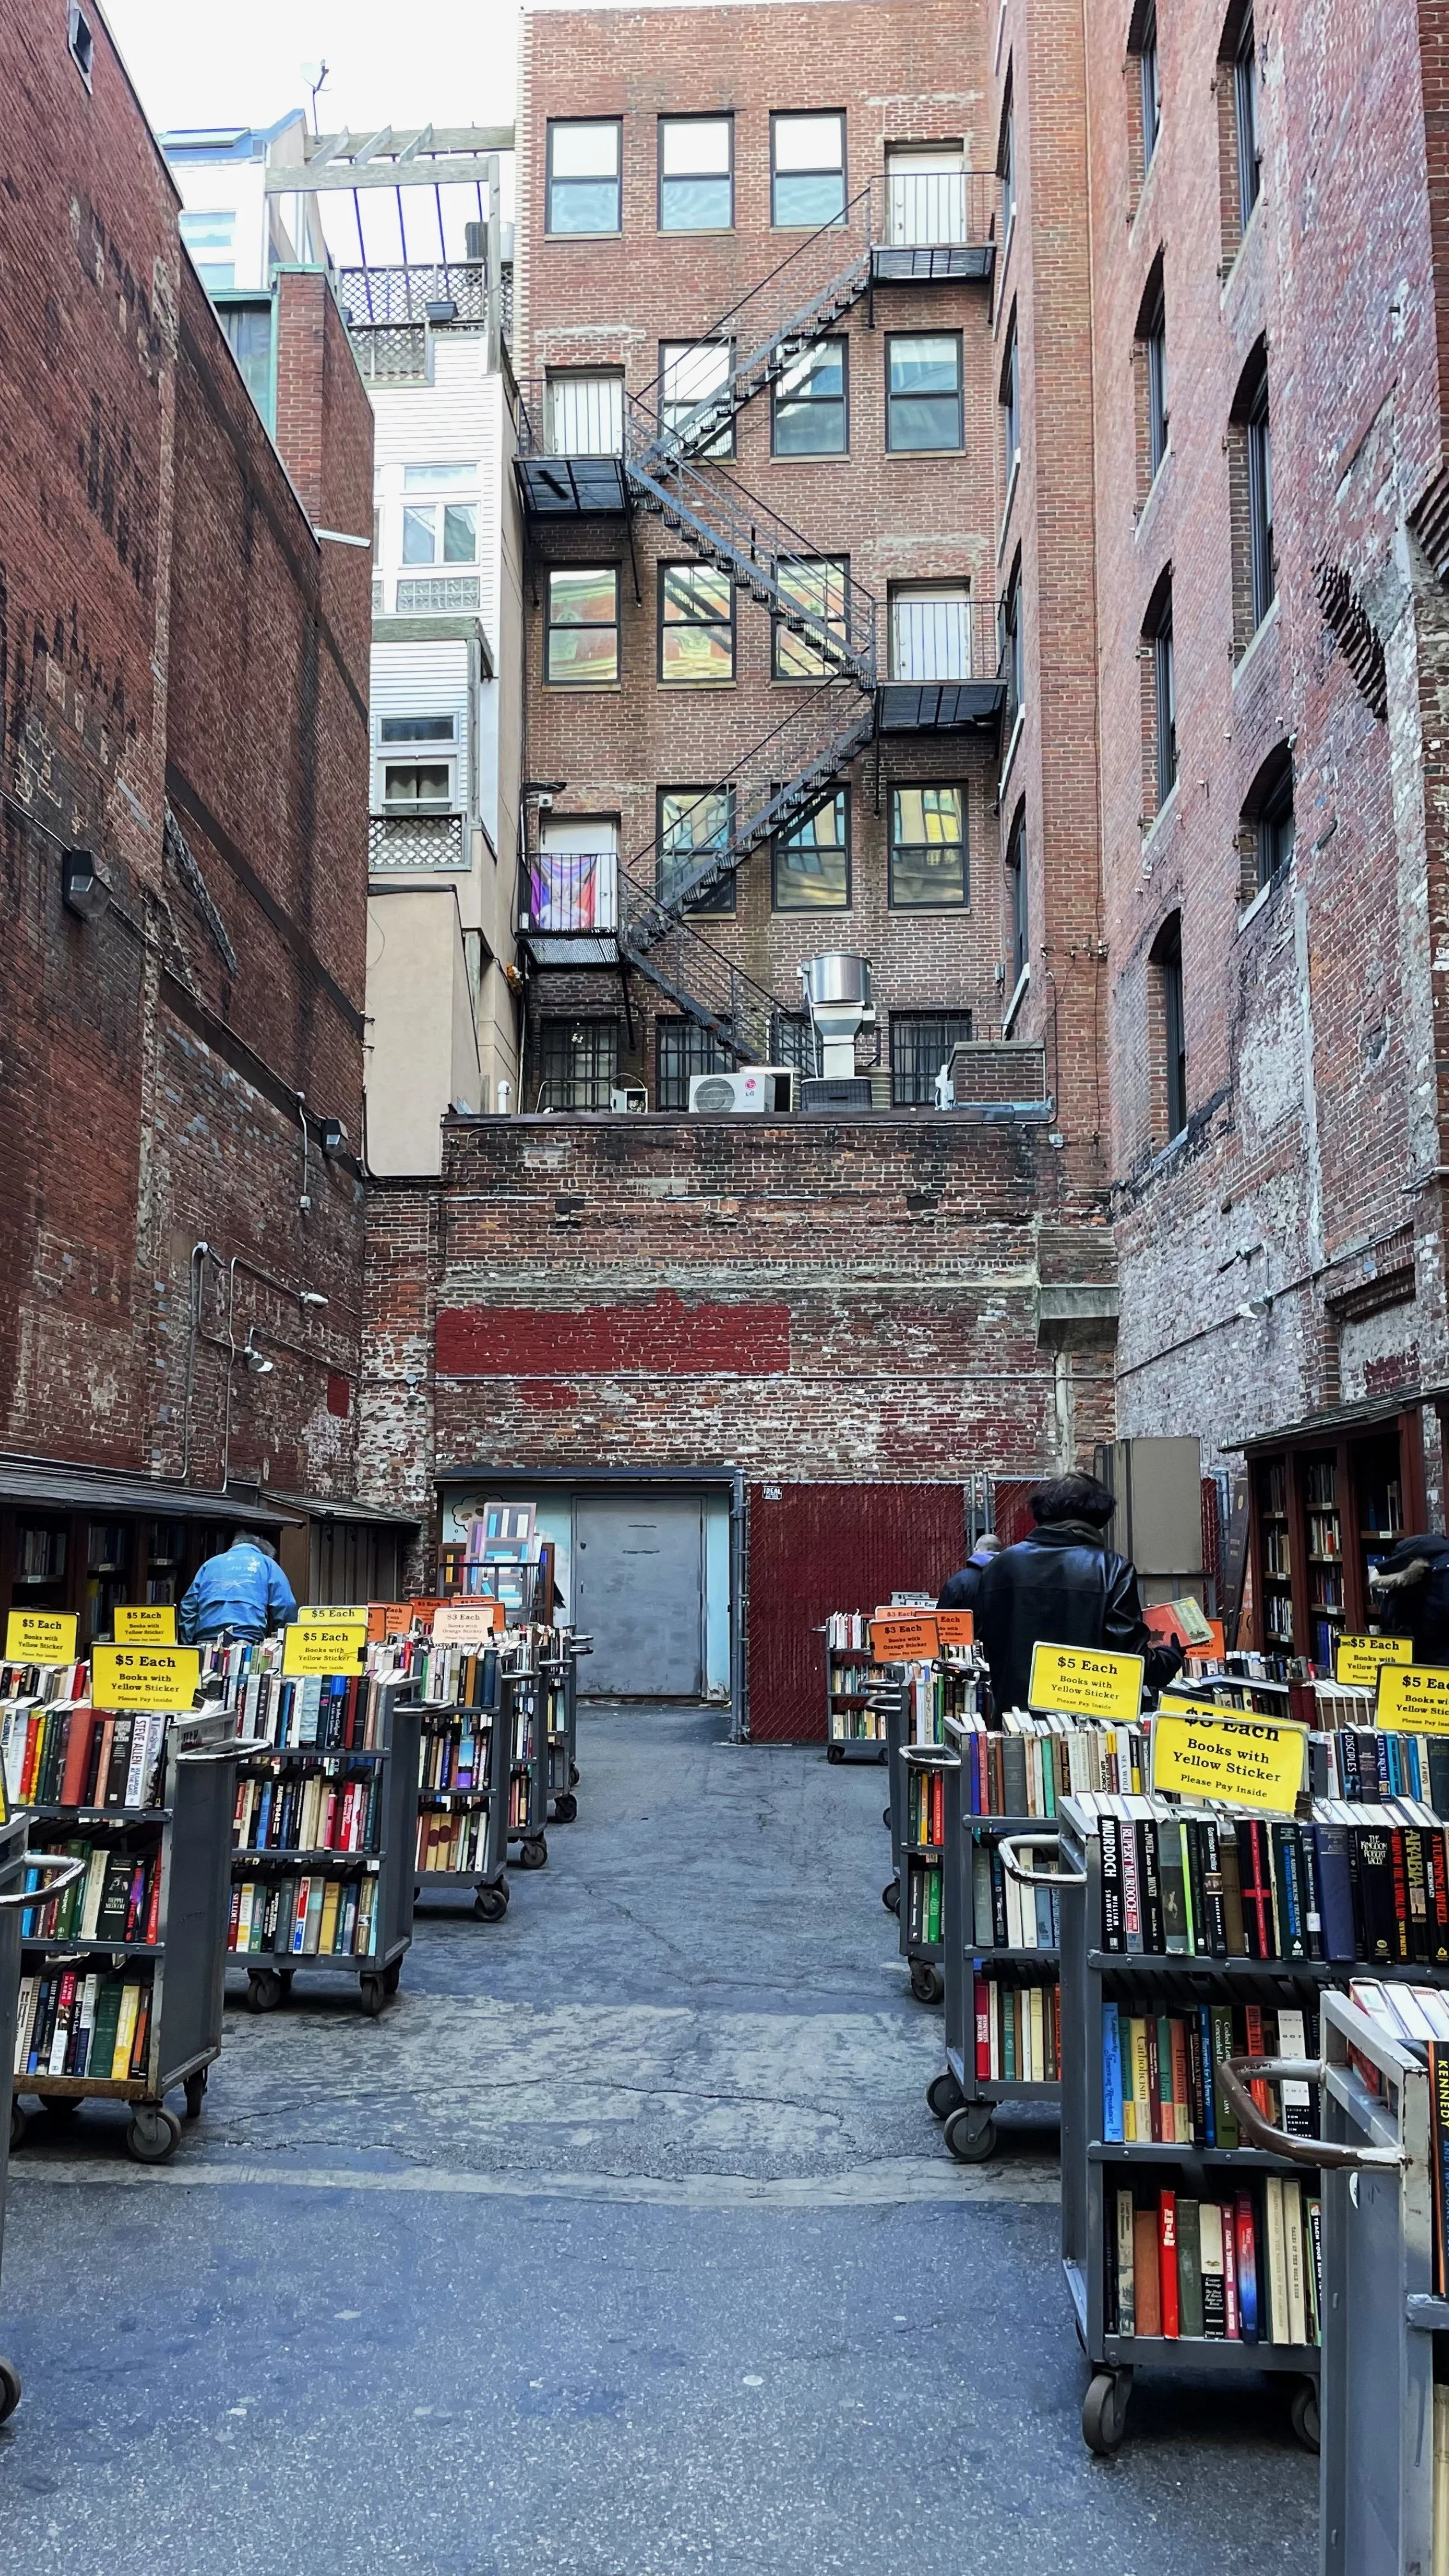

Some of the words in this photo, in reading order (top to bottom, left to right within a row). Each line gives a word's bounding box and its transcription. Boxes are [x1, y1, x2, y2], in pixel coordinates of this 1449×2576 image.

[763, 1487, 782, 1495] IDEAL
[22, 1619, 34, 1628] $5
[38, 1620, 62, 1630] Each
[312, 1609, 326, 1618] $5
[330, 1609, 355, 1618] Each
[303, 1632, 317, 1642] $5
[321, 1632, 348, 1641] Each
[884, 1626, 896, 1634] $3
[900, 1625, 922, 1633] Each
[1351, 1637, 1365, 1648] $5
[1370, 1640, 1399, 1650] Each
[115, 1654, 134, 1666] $5
[139, 1656, 176, 1667] Each
[1057, 1656, 1076, 1668] $5
[1081, 1660, 1118, 1674] Each
[1052, 1684, 1082, 1694] Yellow
[1085, 1689, 1119, 1699] Sticker
[1060, 1675, 1088, 1685] Books
[1092, 1680, 1112, 1689] with
[1402, 1675, 1422, 1688] $5
[258, 1690, 267, 1720] PEARL
[1396, 1704, 1427, 1713] Yellow
[1405, 1695, 1434, 1704] Books
[134, 1720, 147, 1742] STEVE
[1184, 1707, 1214, 1728] $5
[1222, 1716, 1279, 1742] Each
[132, 1742, 144, 1765] ALLEN
[1187, 1738, 1232, 1756] Books
[1238, 1751, 1269, 1764] with
[1344, 1735, 1357, 1773] DISCIPLES
[1173, 1751, 1222, 1770] Yellow
[1226, 1763, 1281, 1782] Sticker
[275, 1786, 284, 1803] JUNE
[1181, 1774, 1211, 1787] Please
[1215, 1781, 1233, 1792] Pay
[1237, 1786, 1268, 1798] Inside
[1101, 1820, 1118, 1878] MURDOCH
[1122, 1827, 1135, 1864] RUPERT
[1145, 1834, 1154, 1853] POWER
[1207, 1827, 1215, 1851] Garrison
[1284, 1845, 1290, 1854] OF
[1361, 1841, 1388, 1850] KINGDOM
[1404, 1829, 1425, 1888] ARABIA
[1432, 1843, 1445, 1889] TURNING
[1393, 1867, 1403, 1880] THE
[1124, 1864, 1137, 1913] MURDOCH
[1147, 1877, 1157, 1897] MONEY
[230, 1892, 240, 1924] SELLOUT
[1105, 1889, 1114, 1932] SHAWCROSS
[1294, 1903, 1302, 1938] TREASURY
[1435, 1890, 1448, 1927] WHEEL
[84, 1981, 96, 2011] NECESSARY
[82, 2013, 91, 2026] EVIL
[1215, 2019, 1223, 2055] Concealed
[1201, 2037, 1210, 2068] Blueprints
[1103, 2050, 1113, 2086] American
[1137, 2035, 1148, 2100] Catholicism
[1176, 2049, 1186, 2103] Hinduism
[1160, 2071, 1170, 2101] Islam
[1204, 2078, 1212, 2106] Memory
[1438, 2059, 1449, 2128] KENNEDY
[1106, 2088, 1114, 2124] Revolution
